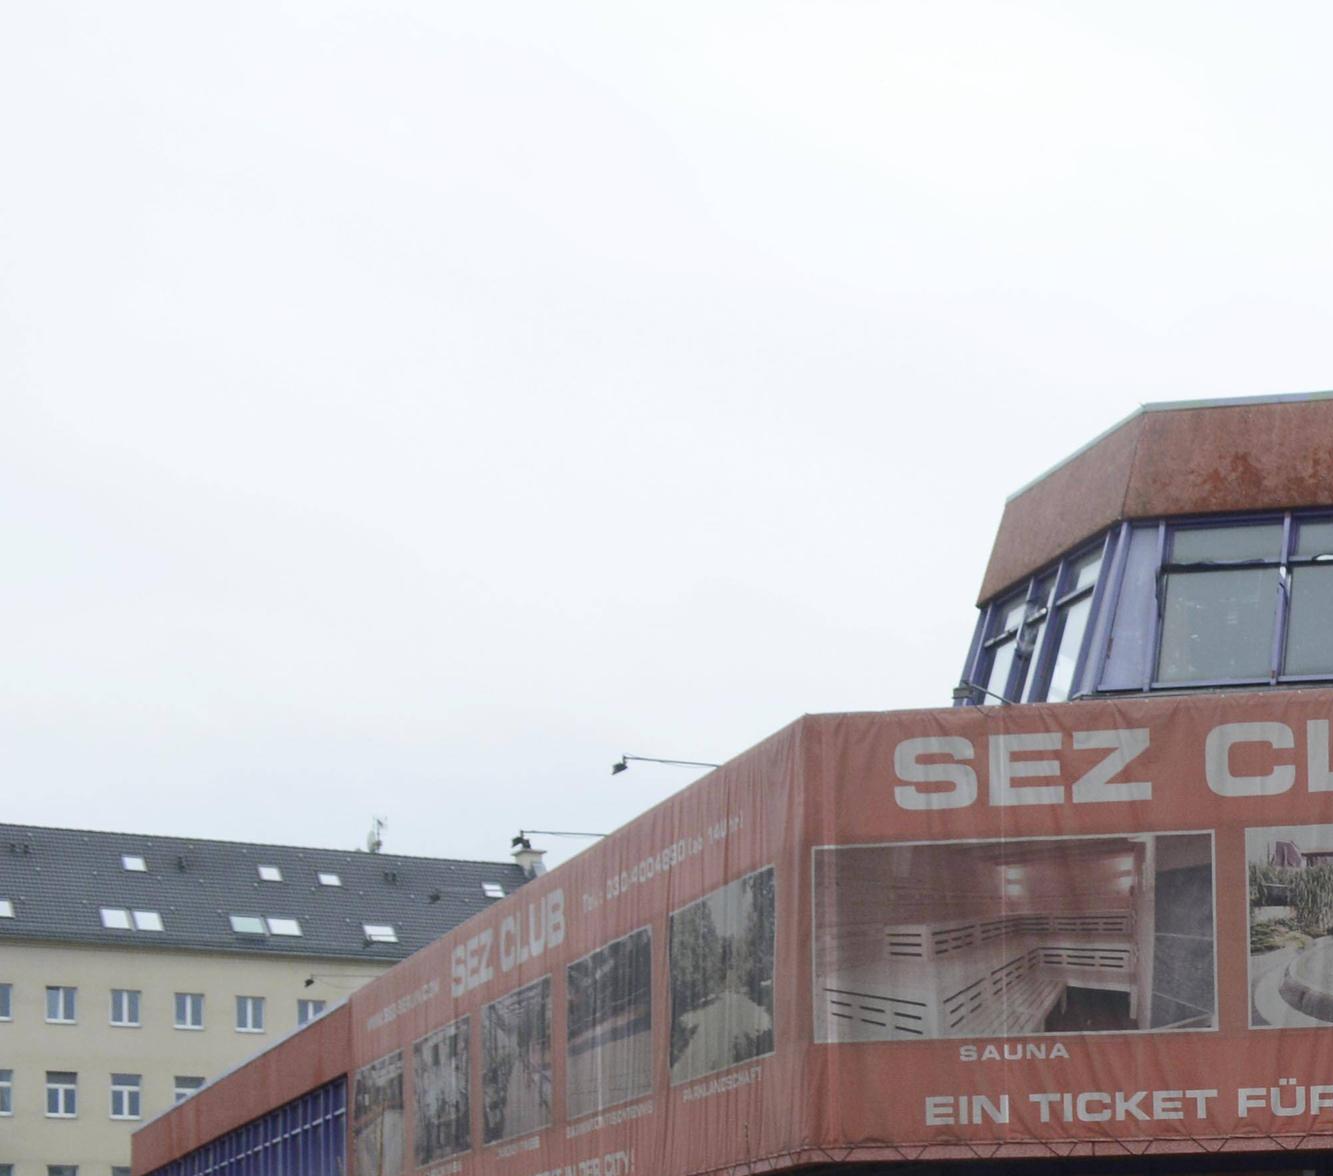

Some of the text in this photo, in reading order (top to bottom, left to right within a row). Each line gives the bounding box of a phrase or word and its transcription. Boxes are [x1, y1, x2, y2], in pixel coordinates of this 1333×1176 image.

[892, 727, 1153, 811] SEZ
[450, 889, 566, 998] SEZ CLUB
[959, 1042, 1070, 1062] SAUNA
[924, 1094, 1011, 1127] EIN
[1029, 1088, 1218, 1125] TICKET
